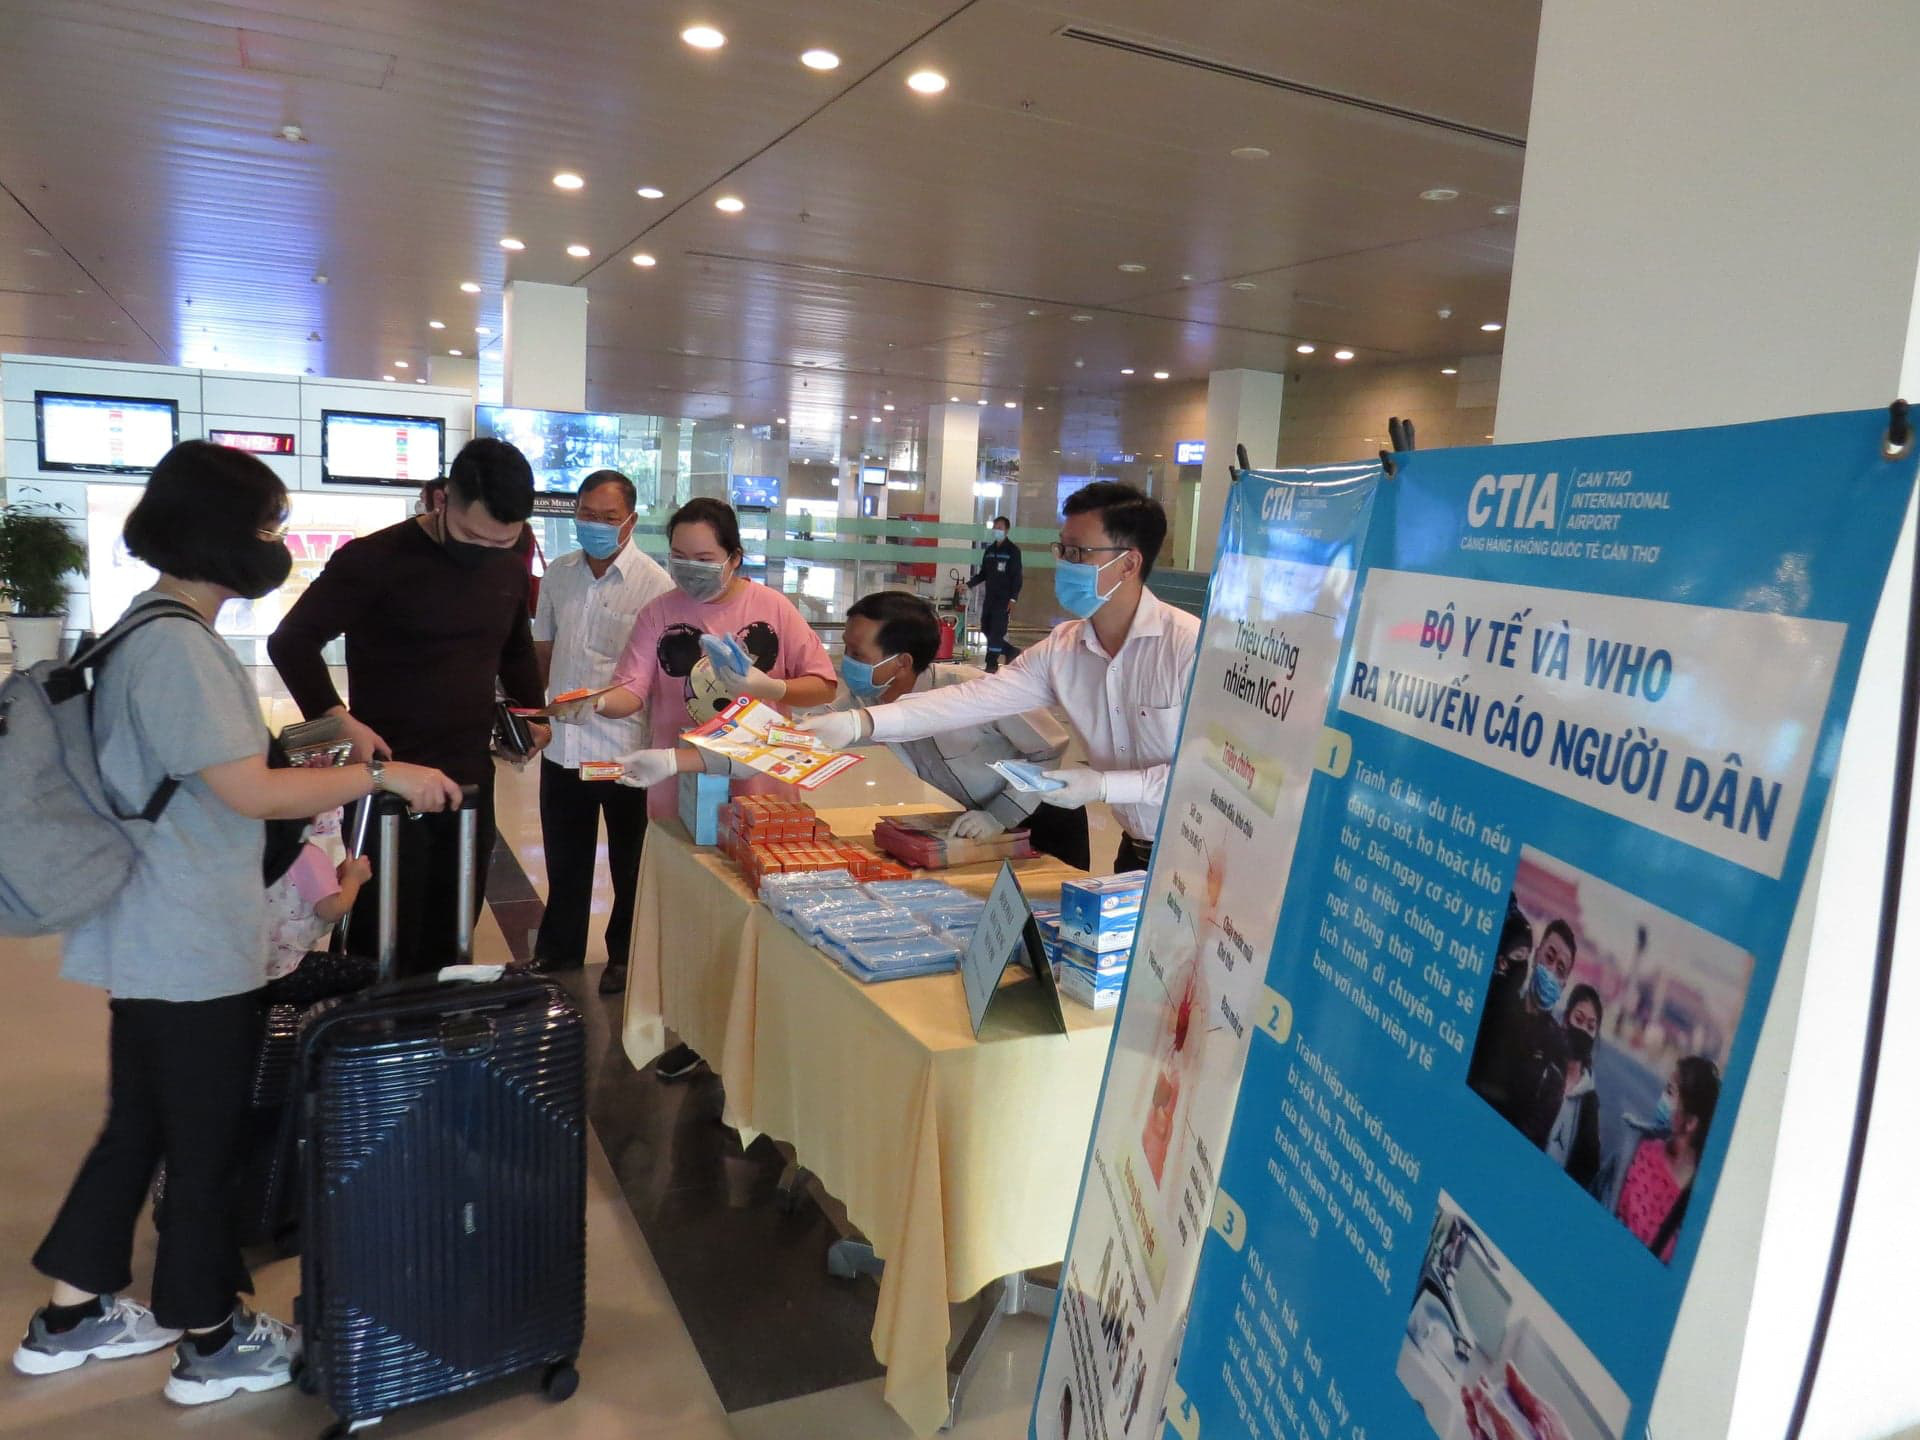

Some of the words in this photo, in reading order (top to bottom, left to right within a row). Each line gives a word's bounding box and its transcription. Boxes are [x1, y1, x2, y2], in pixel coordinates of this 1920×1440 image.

[1261, 487, 1296, 521] CTIA
[1467, 472, 1559, 529] CTIA
[1566, 514, 1621, 530] AIRPORT
[1571, 491, 1670, 510] INTERNATIONAL
[1259, 627, 1300, 681] chứng
[1419, 602, 1456, 660] BỘ
[1462, 615, 1482, 660] Y
[1487, 608, 1534, 669] TẾ
[1531, 620, 1573, 681] VÀ
[1584, 637, 1673, 702] WHO
[1255, 675, 1295, 722] NCoV
[1327, 745, 1338, 769] 1
[1350, 660, 1379, 704] RA
[1383, 668, 1481, 737] KHUYẾN
[1484, 694, 1544, 758] CÁO
[1549, 718, 1668, 802] NGƯỜI
[1674, 752, 1783, 842] DÂN
[1354, 759, 1386, 793] Tránh
[1428, 796, 1447, 823] du
[1451, 804, 1476, 837] lịch
[1480, 824, 1511, 855] nếu
[1347, 795, 1375, 828] đang
[1377, 811, 1391, 832] có
[1417, 828, 1433, 856] ho
[1436, 838, 1468, 877] hoặc
[1472, 858, 1502, 895] khó
[1333, 855, 1352, 883] khi
[1355, 873, 1369, 893] có
[1372, 883, 1399, 918] triệu
[1404, 905, 1445, 952] chứng
[1448, 939, 1485, 976] nghi
[1367, 840, 1390, 872] Đến
[1392, 860, 1424, 895] ngay
[1461, 905, 1473, 927] y
[1477, 909, 1496, 936] tế
[1320, 918, 1339, 947] lịch
[1342, 937, 1368, 971] trình
[1373, 962, 1387, 987] di
[1388, 977, 1434, 1028] chuyển
[1438, 1019, 1466, 1054] của
[1334, 972, 1353, 997] với
[1351, 986, 1380, 1024] nhân
[1381, 1011, 1407, 1049] viên
[1406, 1036, 1420, 1060] y
[1423, 962, 1452, 998] chia
[1267, 1004, 1280, 1032] 2
[1296, 1032, 1323, 1077] Tránh
[1323, 1064, 1344, 1099] tiếp
[1343, 1088, 1365, 1121] xúc
[1364, 1111, 1384, 1142] với
[1382, 1131, 1422, 1185] người
[1275, 1125, 1300, 1168] tránh
[1327, 1192, 1345, 1229] tay
[1344, 1218, 1365, 1254] vào
[1298, 1115, 1315, 1147] tay
[1314, 1131, 1340, 1182] bằng
[1353, 1187, 1393, 1252] phòng,
[1334, 1113, 1375, 1182] Thường
[1374, 1168, 1413, 1225] xuyên
[1222, 1209, 1234, 1236] 3
[1288, 1184, 1320, 1239] miệng
[1248, 1245, 1264, 1281] Khi
